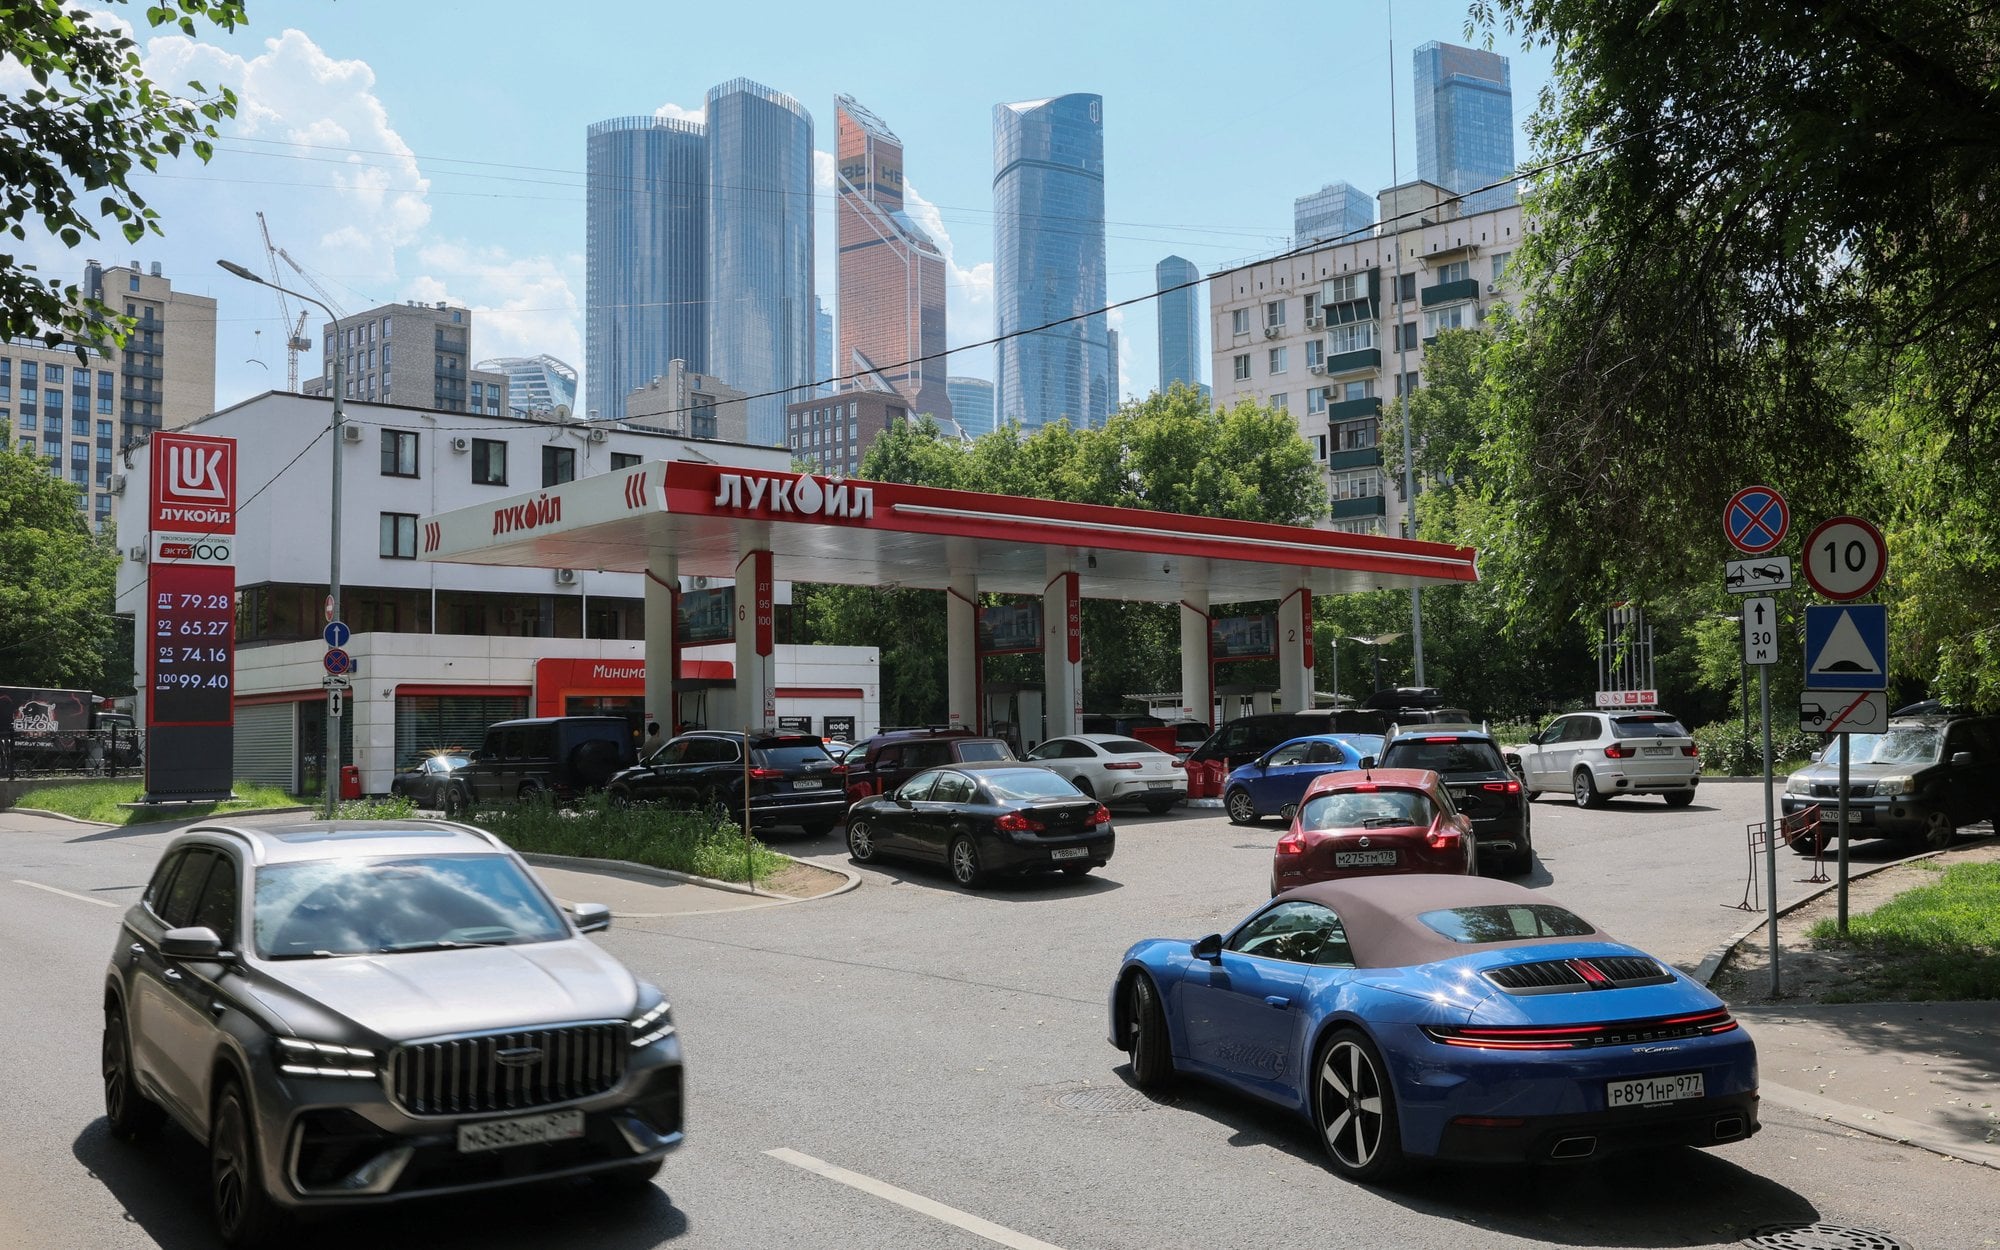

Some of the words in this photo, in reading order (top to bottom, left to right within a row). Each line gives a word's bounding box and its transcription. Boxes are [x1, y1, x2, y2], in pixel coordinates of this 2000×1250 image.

[715, 473, 874, 520] ЛУКОЙЛ
[160, 508, 231, 523] ЛУКОЙЛ
[189, 544, 229, 560] 100
[1823, 540, 1866, 573] 10
[158, 593, 173, 604] ДТ
[181, 594, 228, 609] 79.28
[759, 600, 769, 609] 95
[739, 604, 746, 621] 6
[158, 620, 172, 629] 92
[180, 621, 229, 635] 65.27
[758, 616, 771, 625] 100
[1288, 629, 1296, 642] 2
[1751, 631, 1771, 645] 30
[160, 647, 173, 656] 95
[182, 647, 226, 662] 74.16
[158, 674, 178, 683] 100
[179, 674, 229, 689] 99.40
[14, 719, 59, 732] BIZON
[829, 723, 849, 731] кофе
[1338, 852, 1378, 864] М275ТМ
[1379, 850, 1394, 861] 178
[1594, 1028, 1694, 1043] PORSCHE
[1613, 1081, 1675, 1104] Р891НР
[1677, 1075, 1700, 1092] 977
